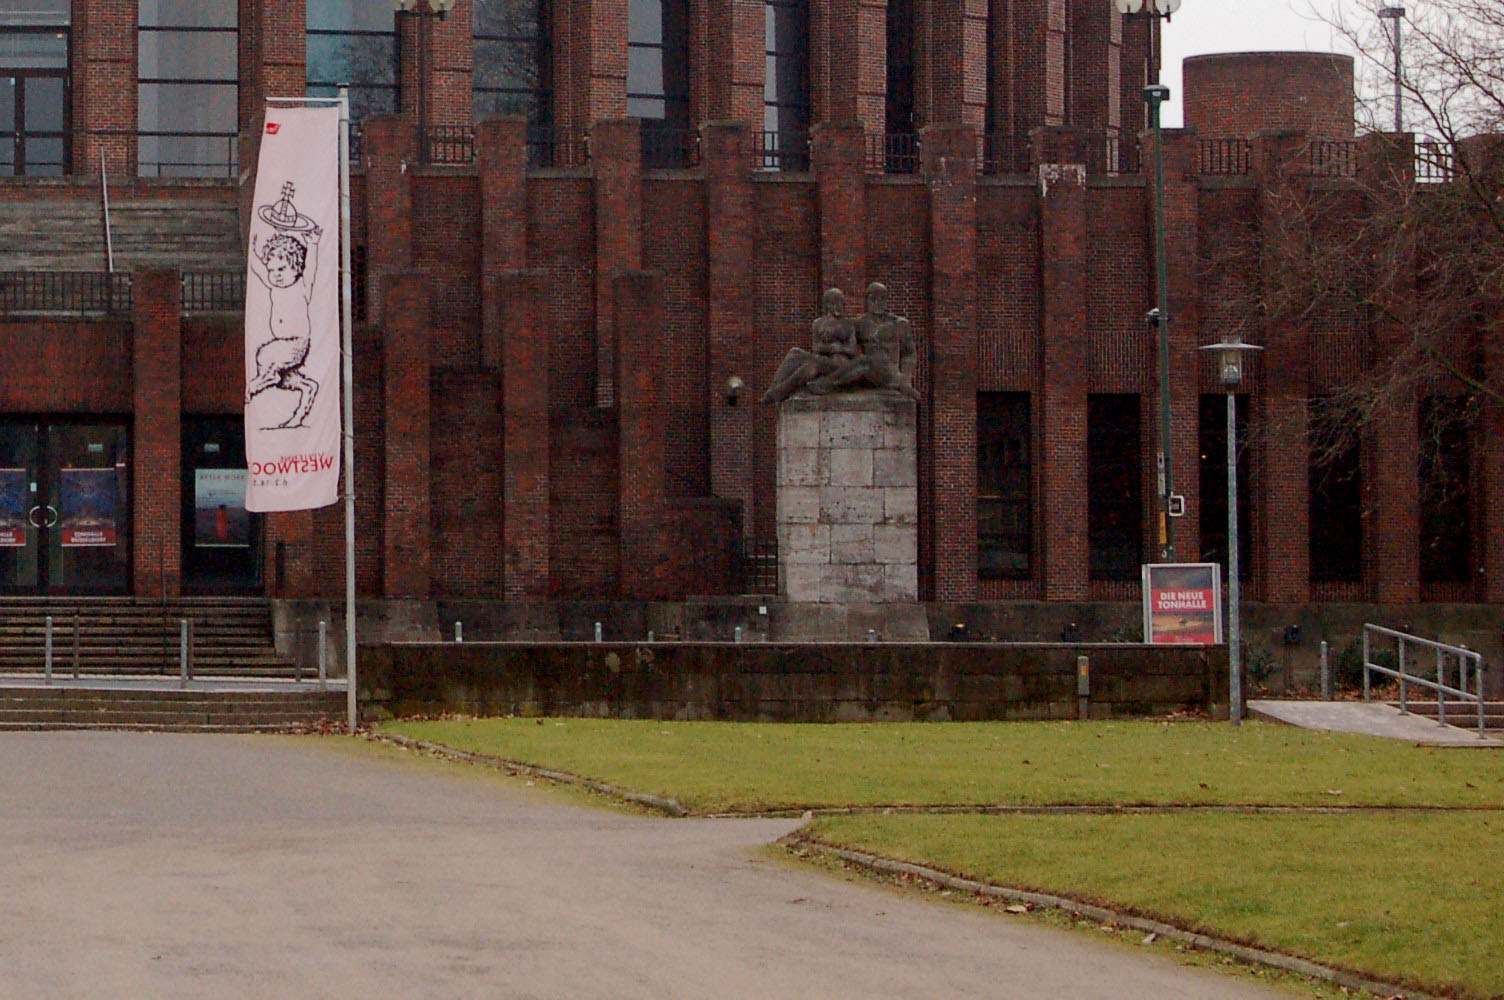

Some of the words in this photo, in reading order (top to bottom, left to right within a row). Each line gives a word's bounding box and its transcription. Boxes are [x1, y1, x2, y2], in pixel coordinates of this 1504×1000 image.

[1160, 592, 1176, 600] DIE
[1177, 592, 1204, 600] NEUE
[1157, 600, 1207, 609] TONHALLE
